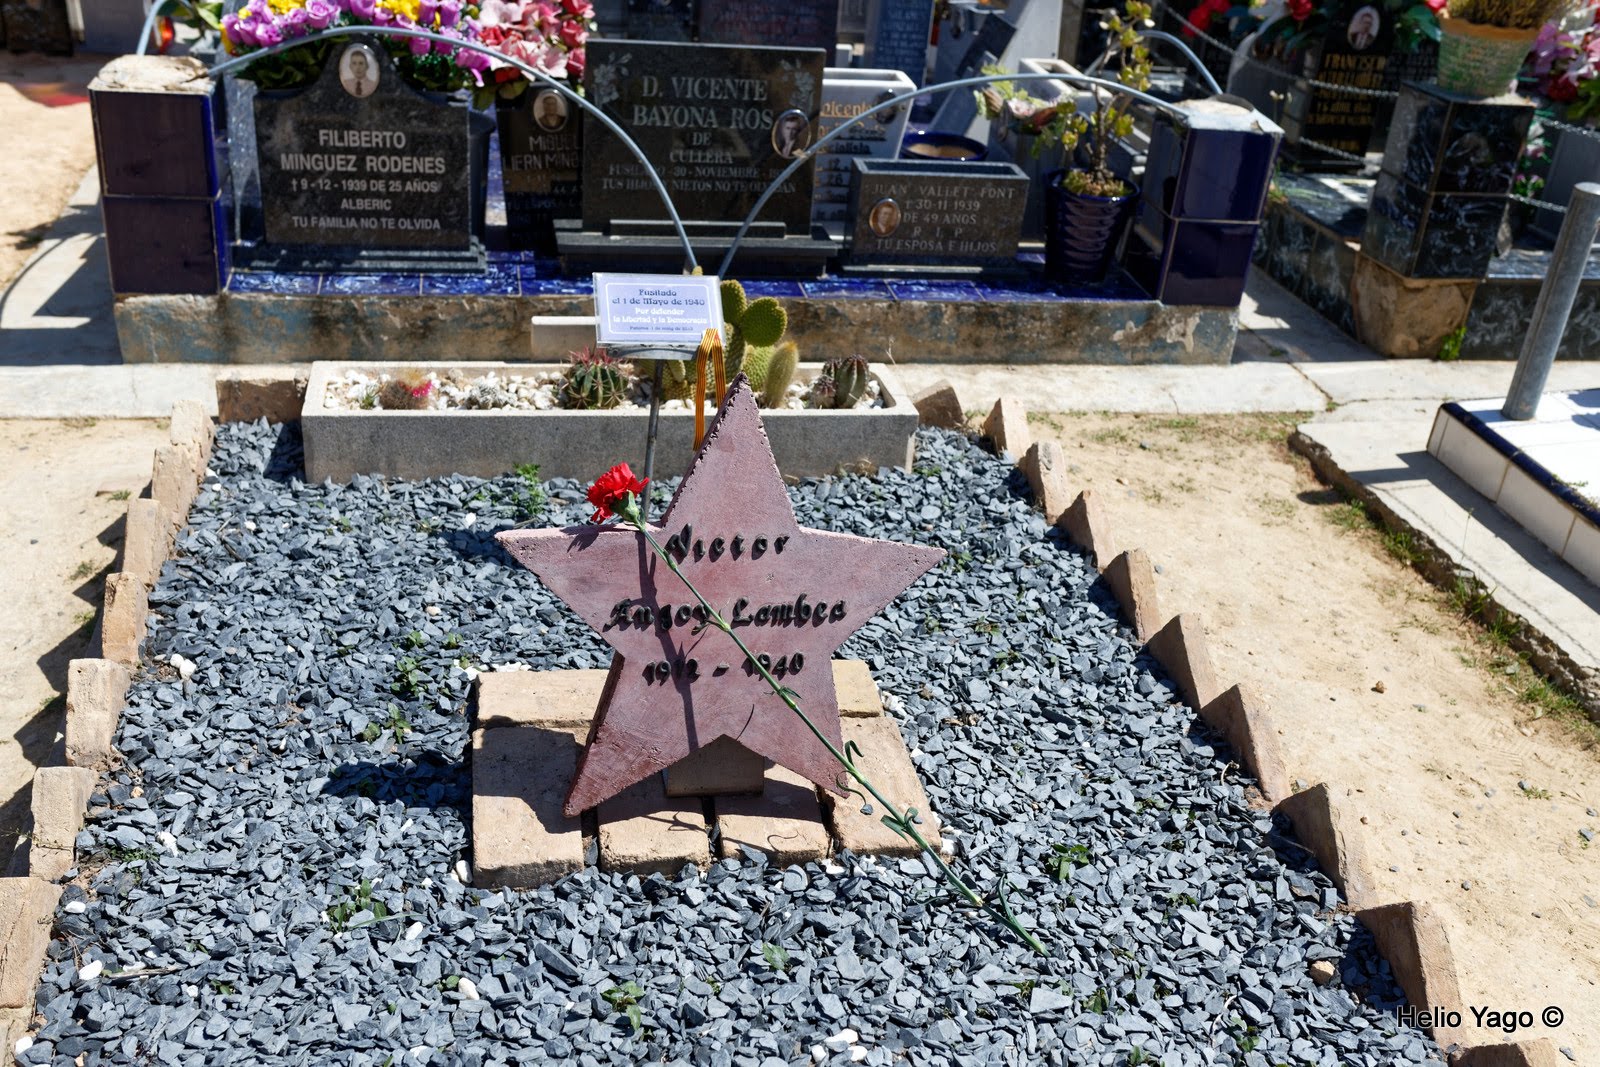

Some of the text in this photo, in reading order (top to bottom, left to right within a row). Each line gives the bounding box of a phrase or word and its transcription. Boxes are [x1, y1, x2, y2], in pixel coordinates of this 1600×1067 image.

[642, 76, 768, 101] D. VICENTE
[632, 105, 774, 131] BAYONA ROS
[318, 129, 407, 149] FILIBERTO
[692, 131, 712, 146] DE
[280, 153, 446, 174] MINGUEZ RODENES
[669, 149, 734, 165] CULLERA
[694, 166, 760, 178] NOVIEMBRE
[341, 179, 367, 192] 1939
[370, 180, 386, 192] DE
[388, 180, 403, 192] 25
[405, 178, 439, 193] AÑOS
[602, 178, 624, 190] TUS
[672, 179, 714, 192] NIETOS
[715, 179, 731, 192] NO
[872, 184, 908, 195] JUAN
[980, 187, 1016, 199] FONT
[340, 198, 392, 211] ALBERIC
[292, 216, 441, 230] TU FAMILIA NO TE OLVIDA
[903, 212, 918, 224] DE
[923, 213, 939, 224] 49
[876, 239, 894, 251] TU
[895, 239, 943, 252] ESPOSA
[960, 240, 997, 253] HIJOS
[638, 288, 677, 297] Fusilado
[629, 297, 640, 305] de
[643, 297, 669, 307] Mayo
[671, 298, 682, 306] de
[650, 308, 685, 316] defender
[613, 315, 621, 323] la
[666, 316, 708, 325] Democracia
[731, 593, 847, 627] Lambea
